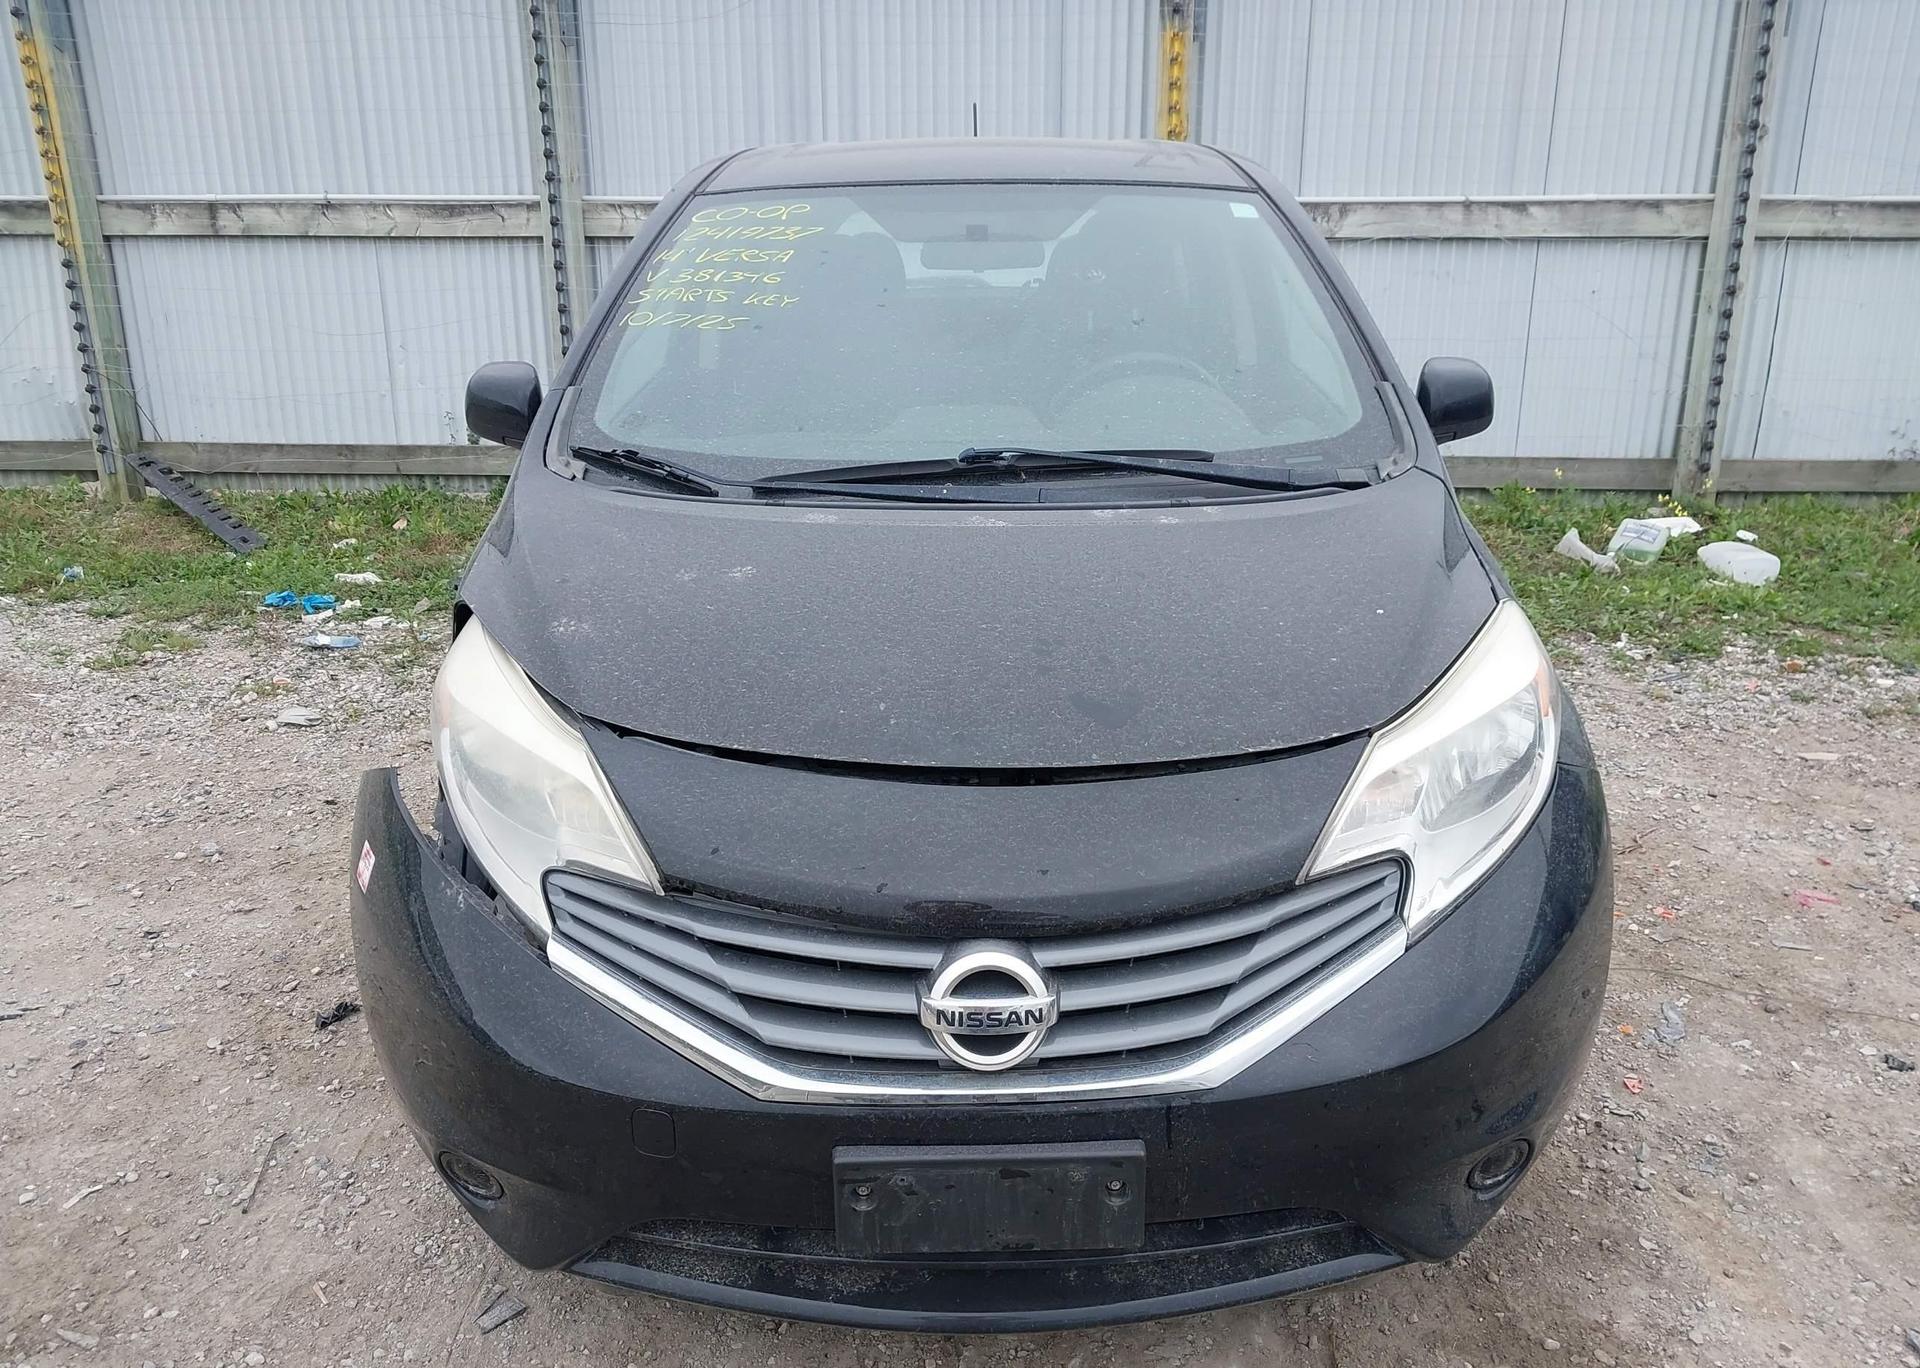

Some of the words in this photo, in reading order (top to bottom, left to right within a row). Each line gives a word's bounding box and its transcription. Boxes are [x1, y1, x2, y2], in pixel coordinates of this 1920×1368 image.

[695, 247, 795, 264] VERSA
[628, 287, 736, 304] STARTS
[742, 294, 801, 307] KEY
[935, 1007, 1044, 1028] NISSAN
